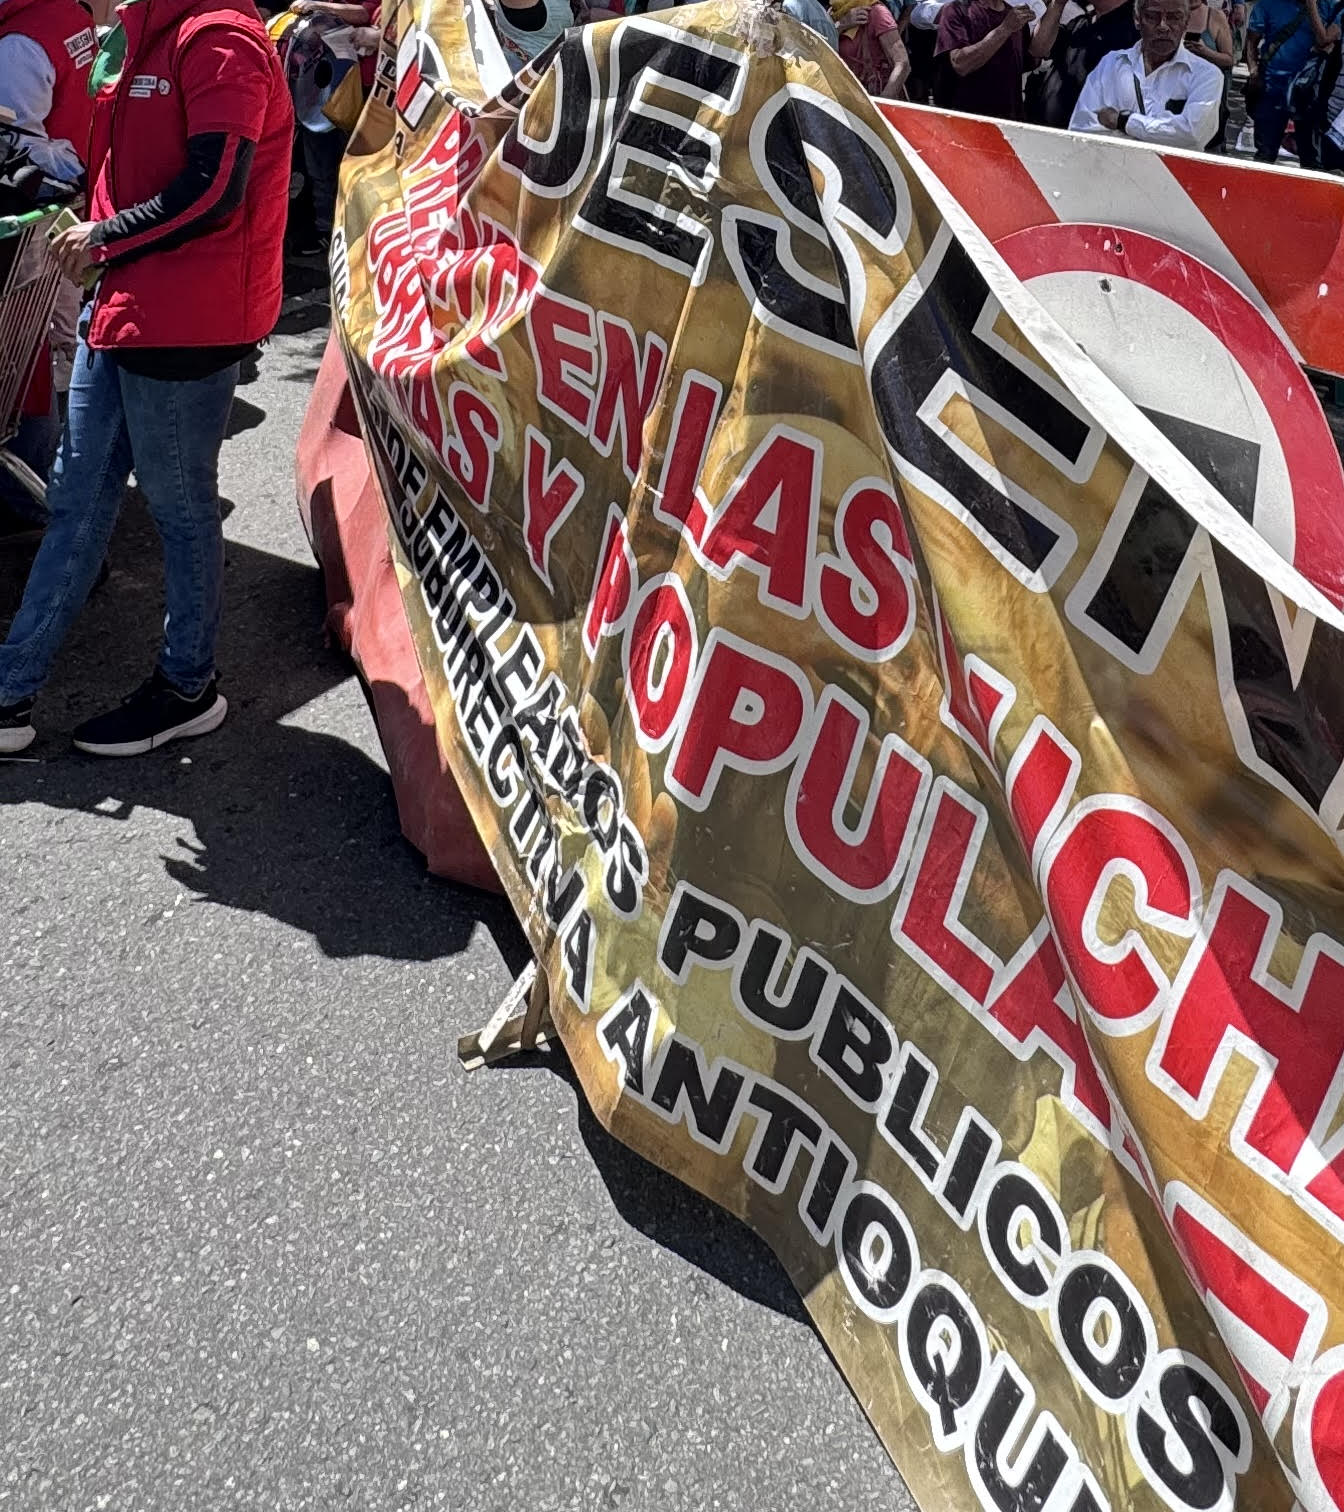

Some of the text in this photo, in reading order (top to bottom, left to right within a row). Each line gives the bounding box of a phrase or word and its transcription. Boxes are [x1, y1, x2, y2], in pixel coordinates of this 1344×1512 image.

[523, 424, 586, 596] Y
[595, 979, 1114, 1512] ANTIOQU
[657, 878, 1254, 1512] PUBLICOS
